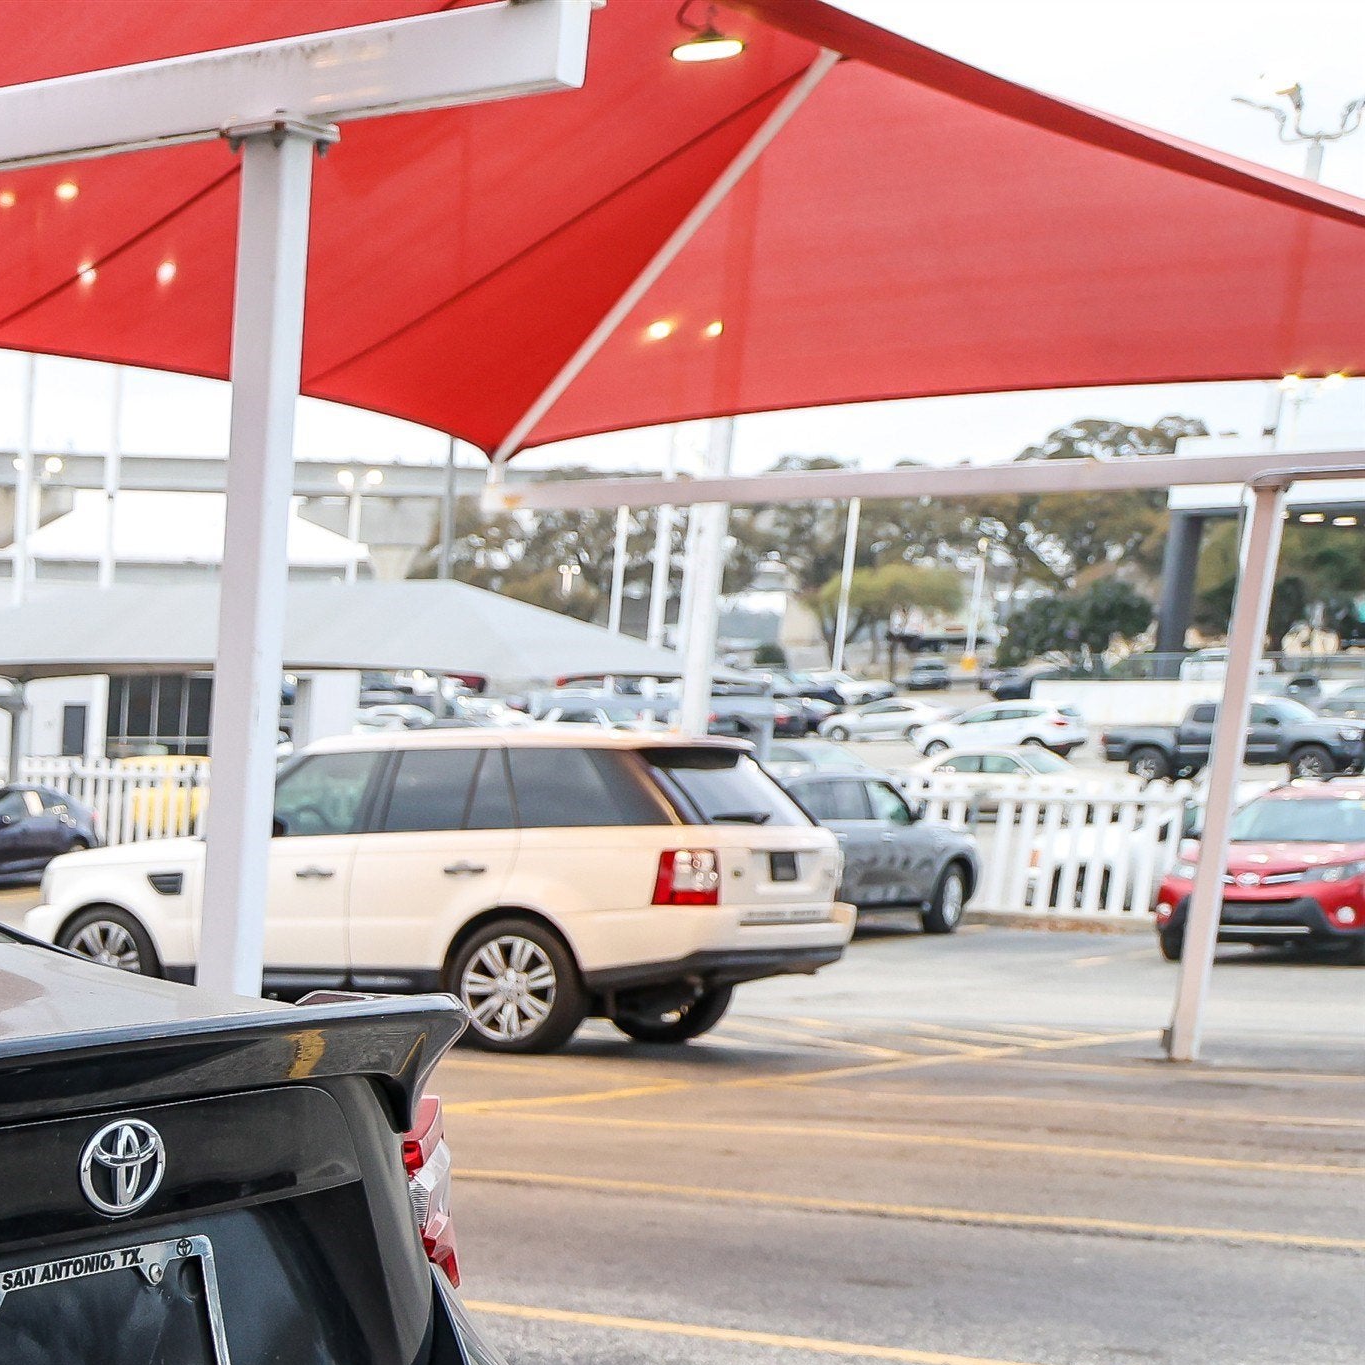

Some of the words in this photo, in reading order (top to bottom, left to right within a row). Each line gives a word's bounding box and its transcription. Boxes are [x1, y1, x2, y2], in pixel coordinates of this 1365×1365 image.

[1, 1267, 37, 1291] SAN
[39, 1253, 116, 1284] ANTONIO,
[120, 1247, 144, 1267] TX.
